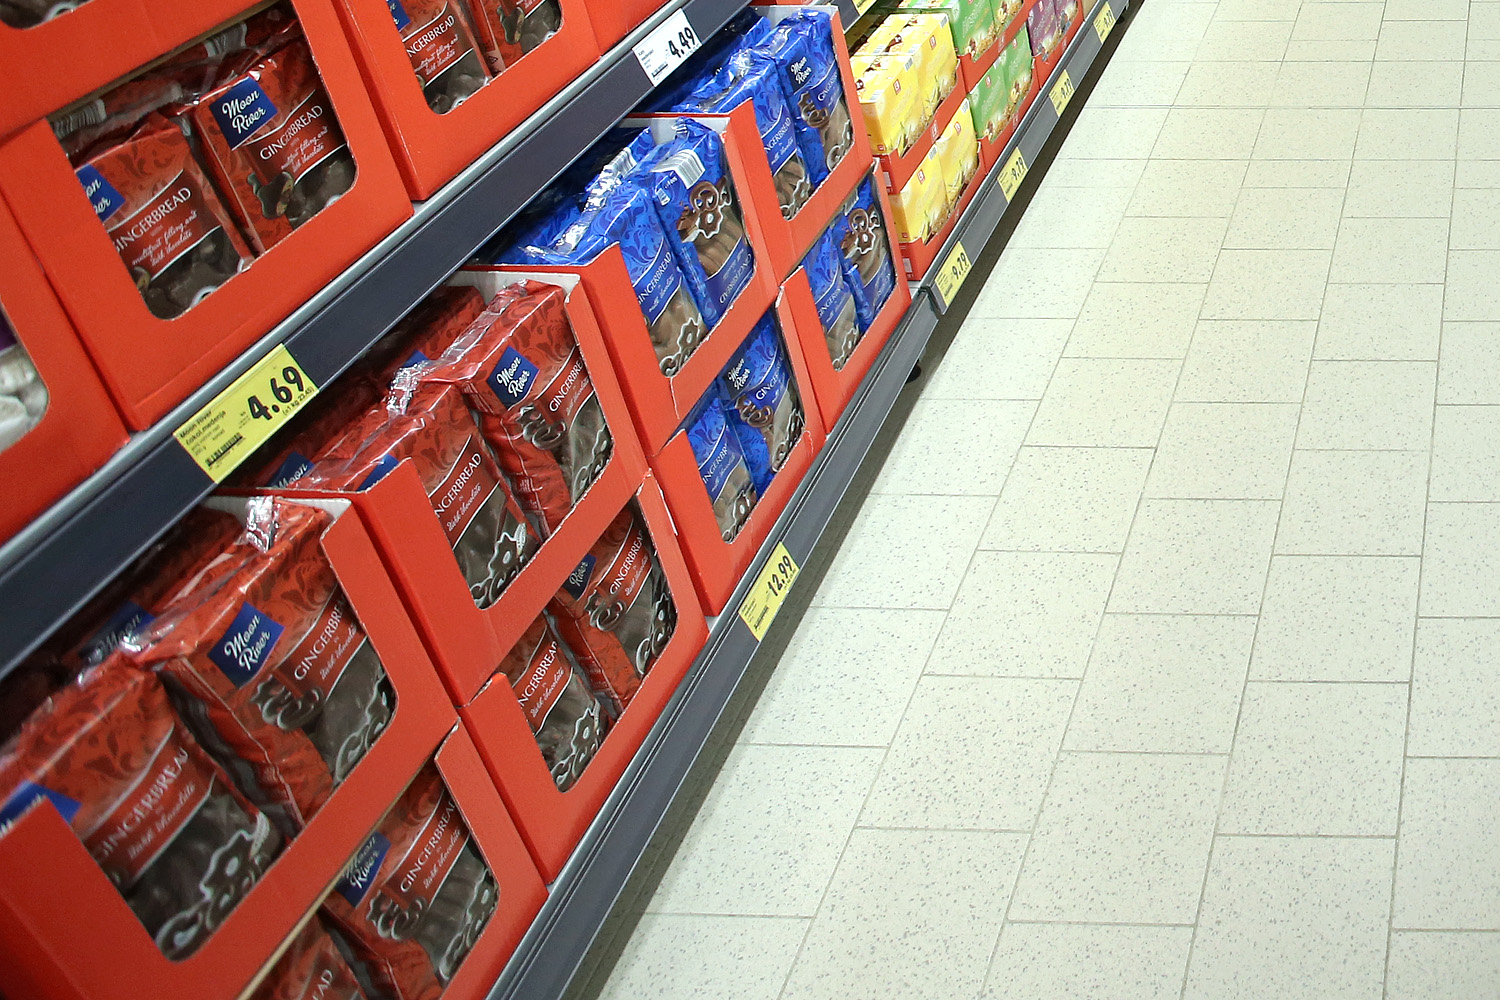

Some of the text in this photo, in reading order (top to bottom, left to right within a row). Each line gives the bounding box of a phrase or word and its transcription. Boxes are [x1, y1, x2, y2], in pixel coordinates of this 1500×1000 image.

[406, 13, 456, 56] NGERBREAD
[668, 27, 698, 57] 4.49
[222, 90, 260, 118] Moon
[232, 105, 267, 134] River
[259, 104, 325, 161] GINGERBREAD
[496, 354, 521, 387] Moon
[507, 370, 531, 399] River
[248, 366, 305, 421] 4.69
[766, 554, 793, 598] 12.99
[224, 614, 261, 658] Moon
[238, 631, 272, 672] River
[349, 850, 380, 889] River
